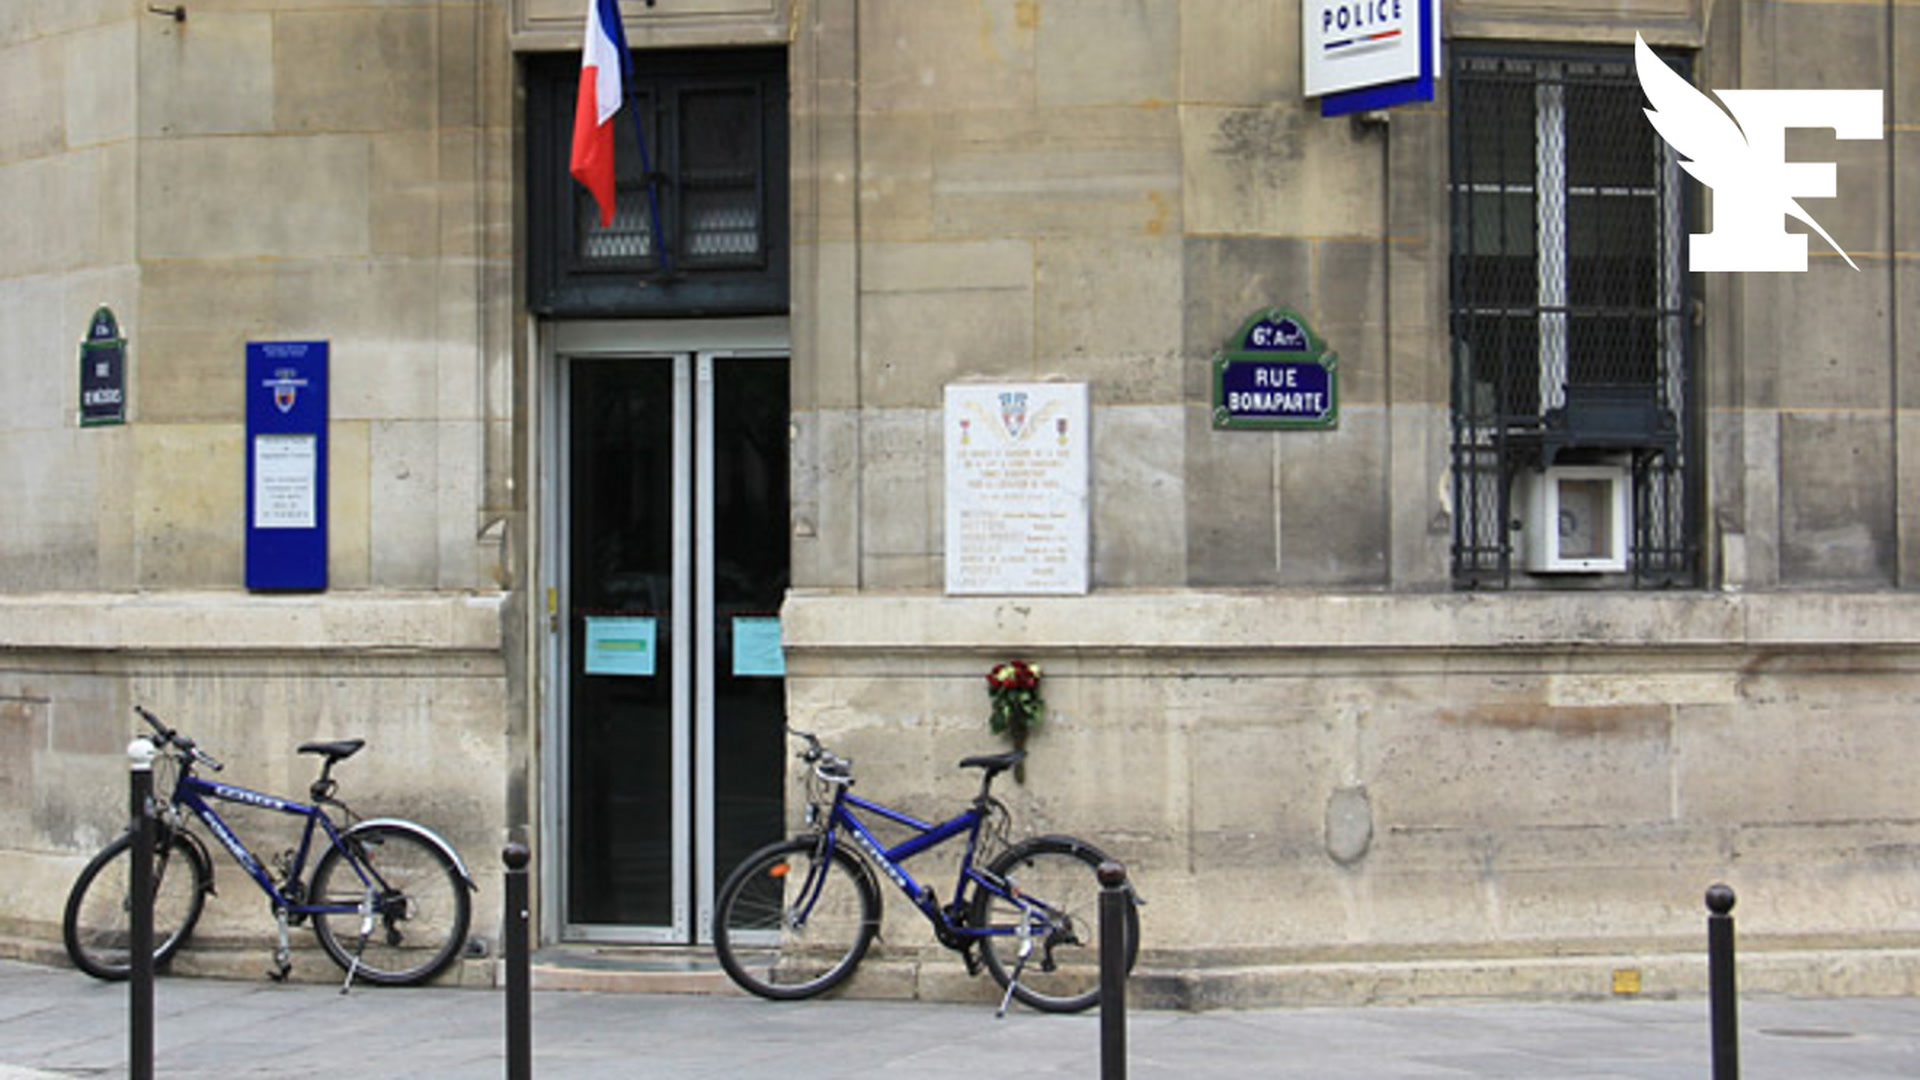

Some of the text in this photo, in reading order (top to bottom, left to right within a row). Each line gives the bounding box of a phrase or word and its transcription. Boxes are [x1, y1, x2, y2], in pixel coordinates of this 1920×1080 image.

[1323, 0, 1401, 33] POLICE
[1255, 367, 1297, 387] RUE
[1228, 392, 1322, 412] BONAPARTE
